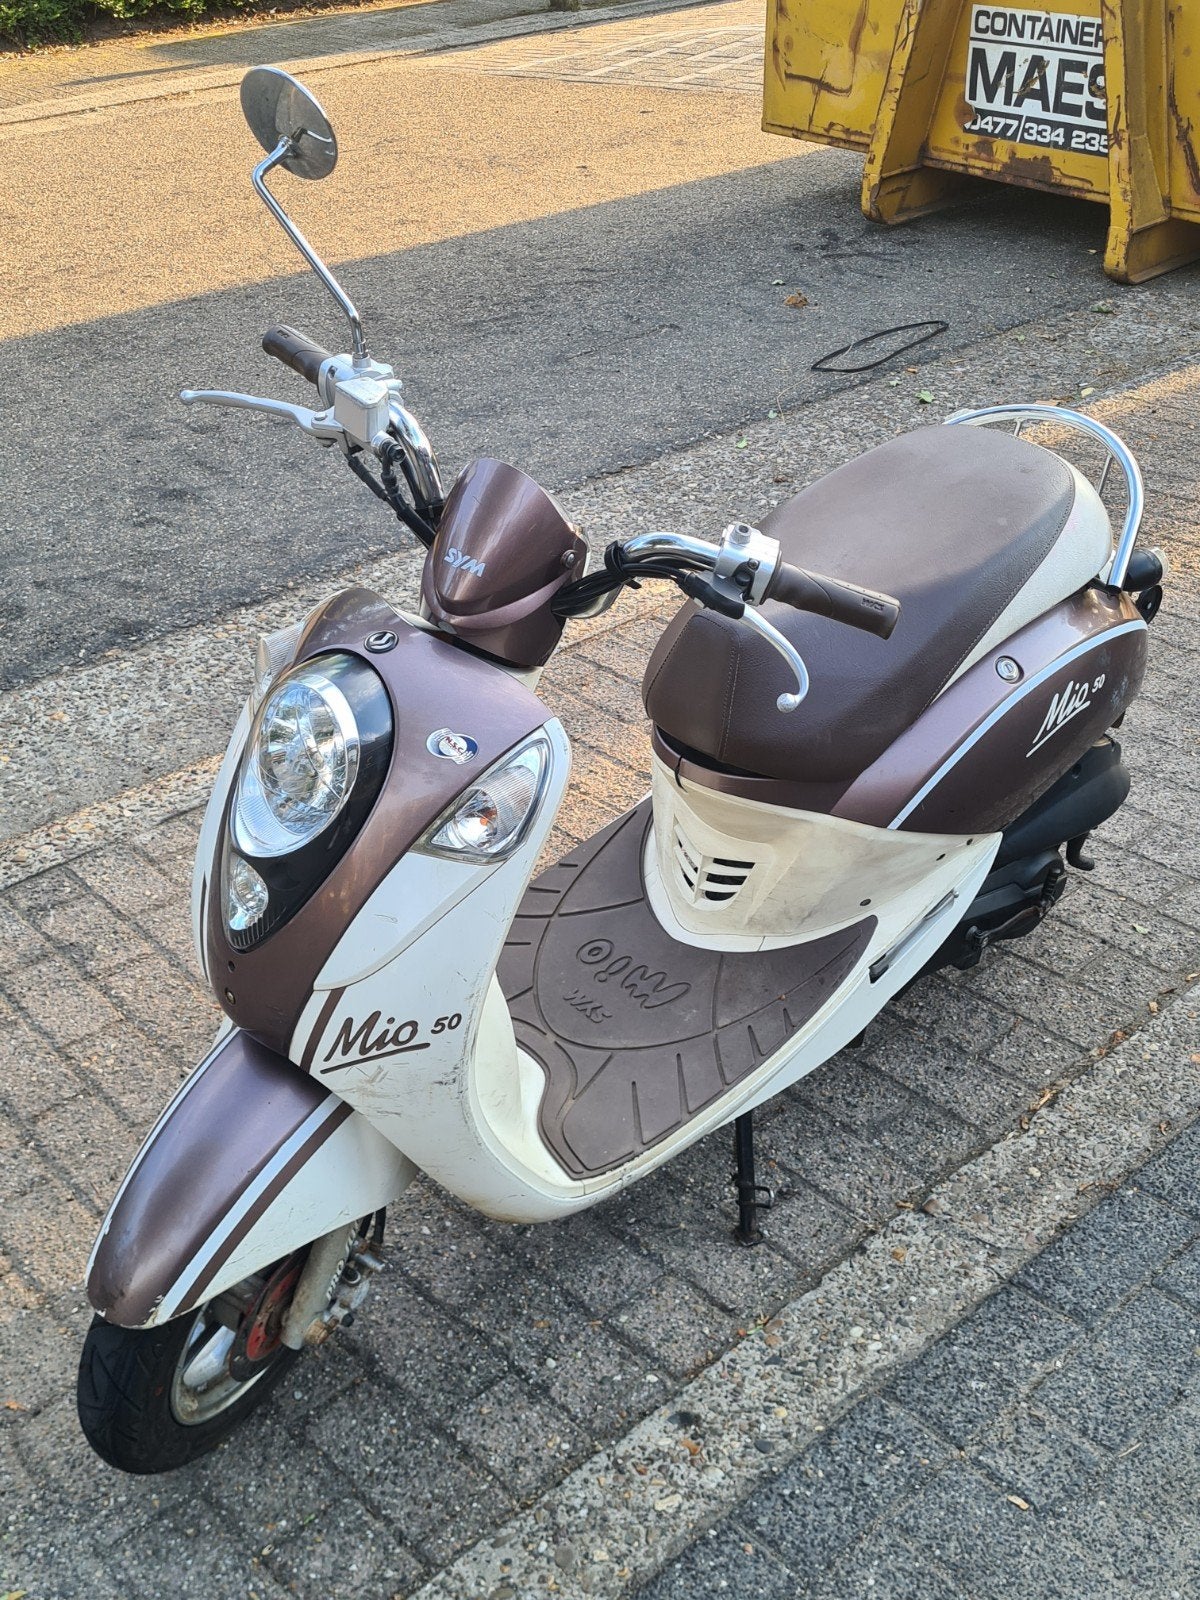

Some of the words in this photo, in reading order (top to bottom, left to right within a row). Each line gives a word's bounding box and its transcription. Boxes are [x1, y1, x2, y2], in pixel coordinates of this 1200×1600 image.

[969, 47, 1107, 122] MAES
[444, 547, 486, 577] SYM
[1031, 680, 1090, 746] Mio
[1091, 673, 1106, 693] 50
[322, 1010, 420, 1063] Mio
[430, 1013, 462, 1035] 50
